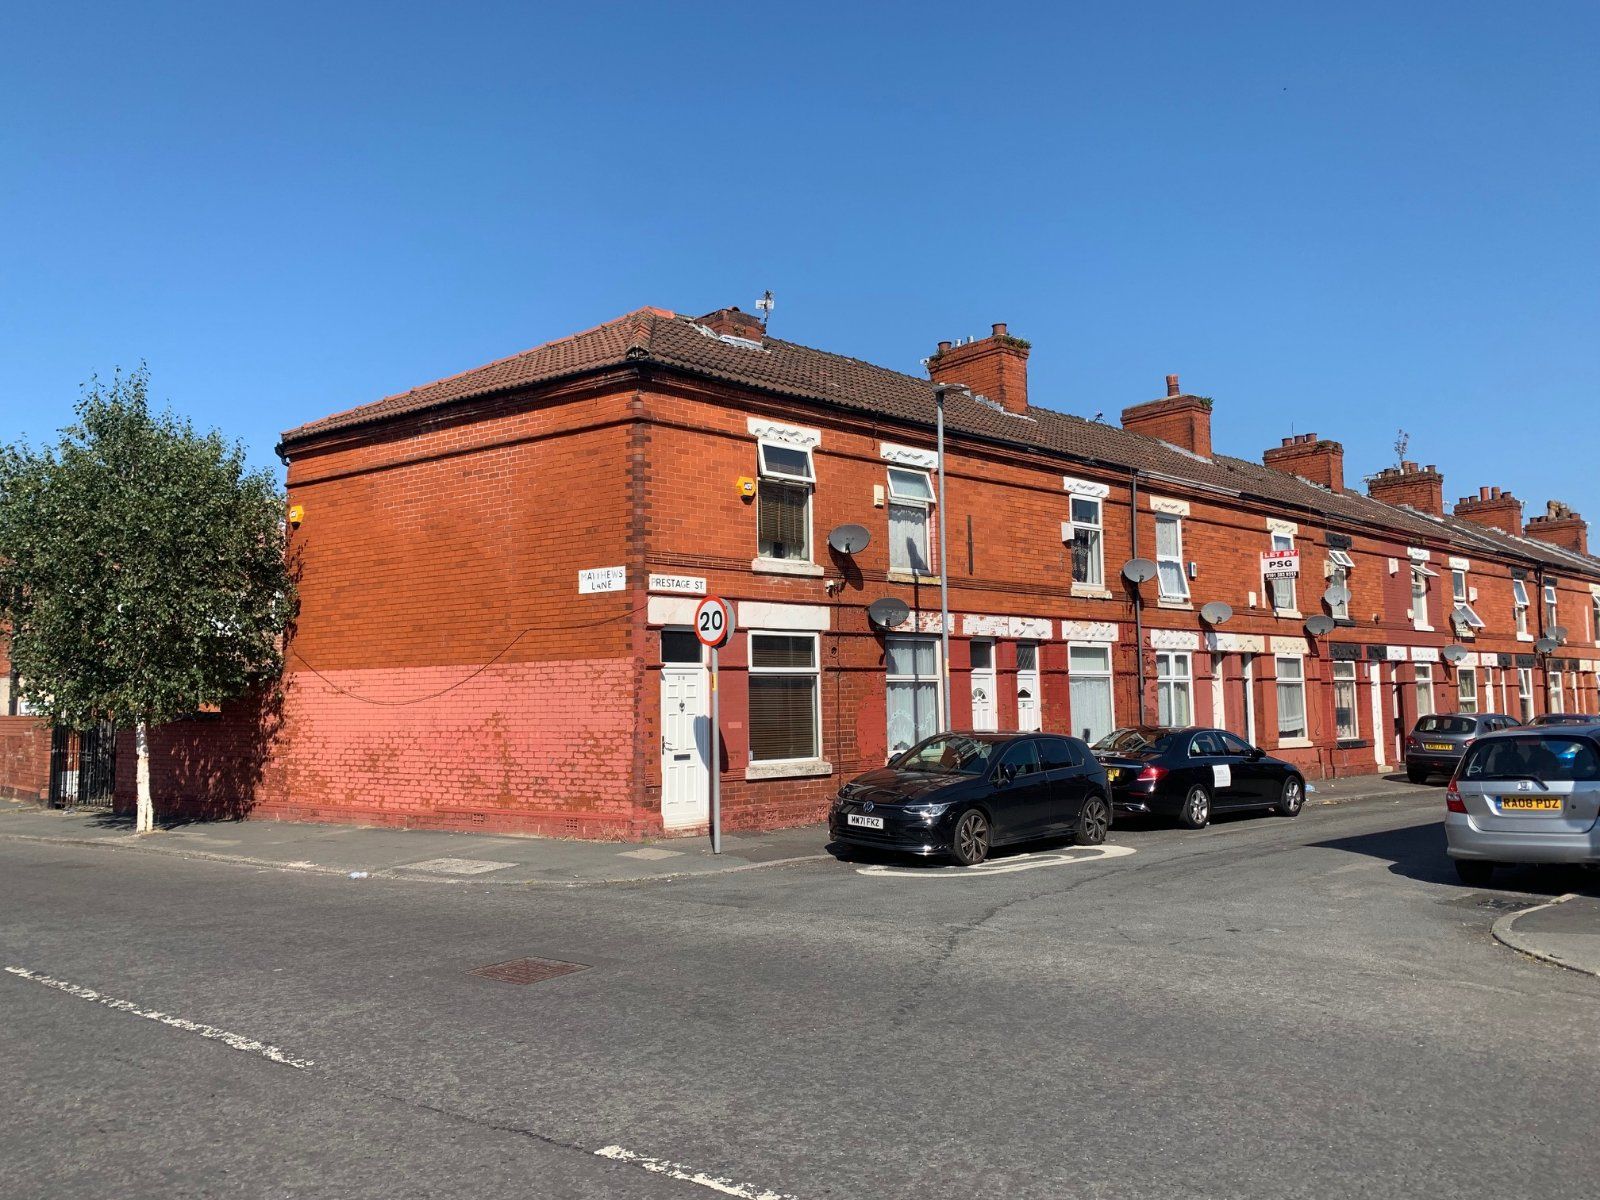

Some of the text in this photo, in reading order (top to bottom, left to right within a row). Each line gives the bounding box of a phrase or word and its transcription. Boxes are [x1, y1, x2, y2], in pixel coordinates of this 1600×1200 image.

[1264, 549, 1297, 559] LET BY
[1269, 560, 1293, 568] PSG
[591, 580, 612, 591] LANE
[651, 578, 690, 589] PRESTAGE
[700, 610, 723, 631] 20
[1503, 798, 1560, 808] RA08 PDZ
[866, 817, 880, 827] FKZ
